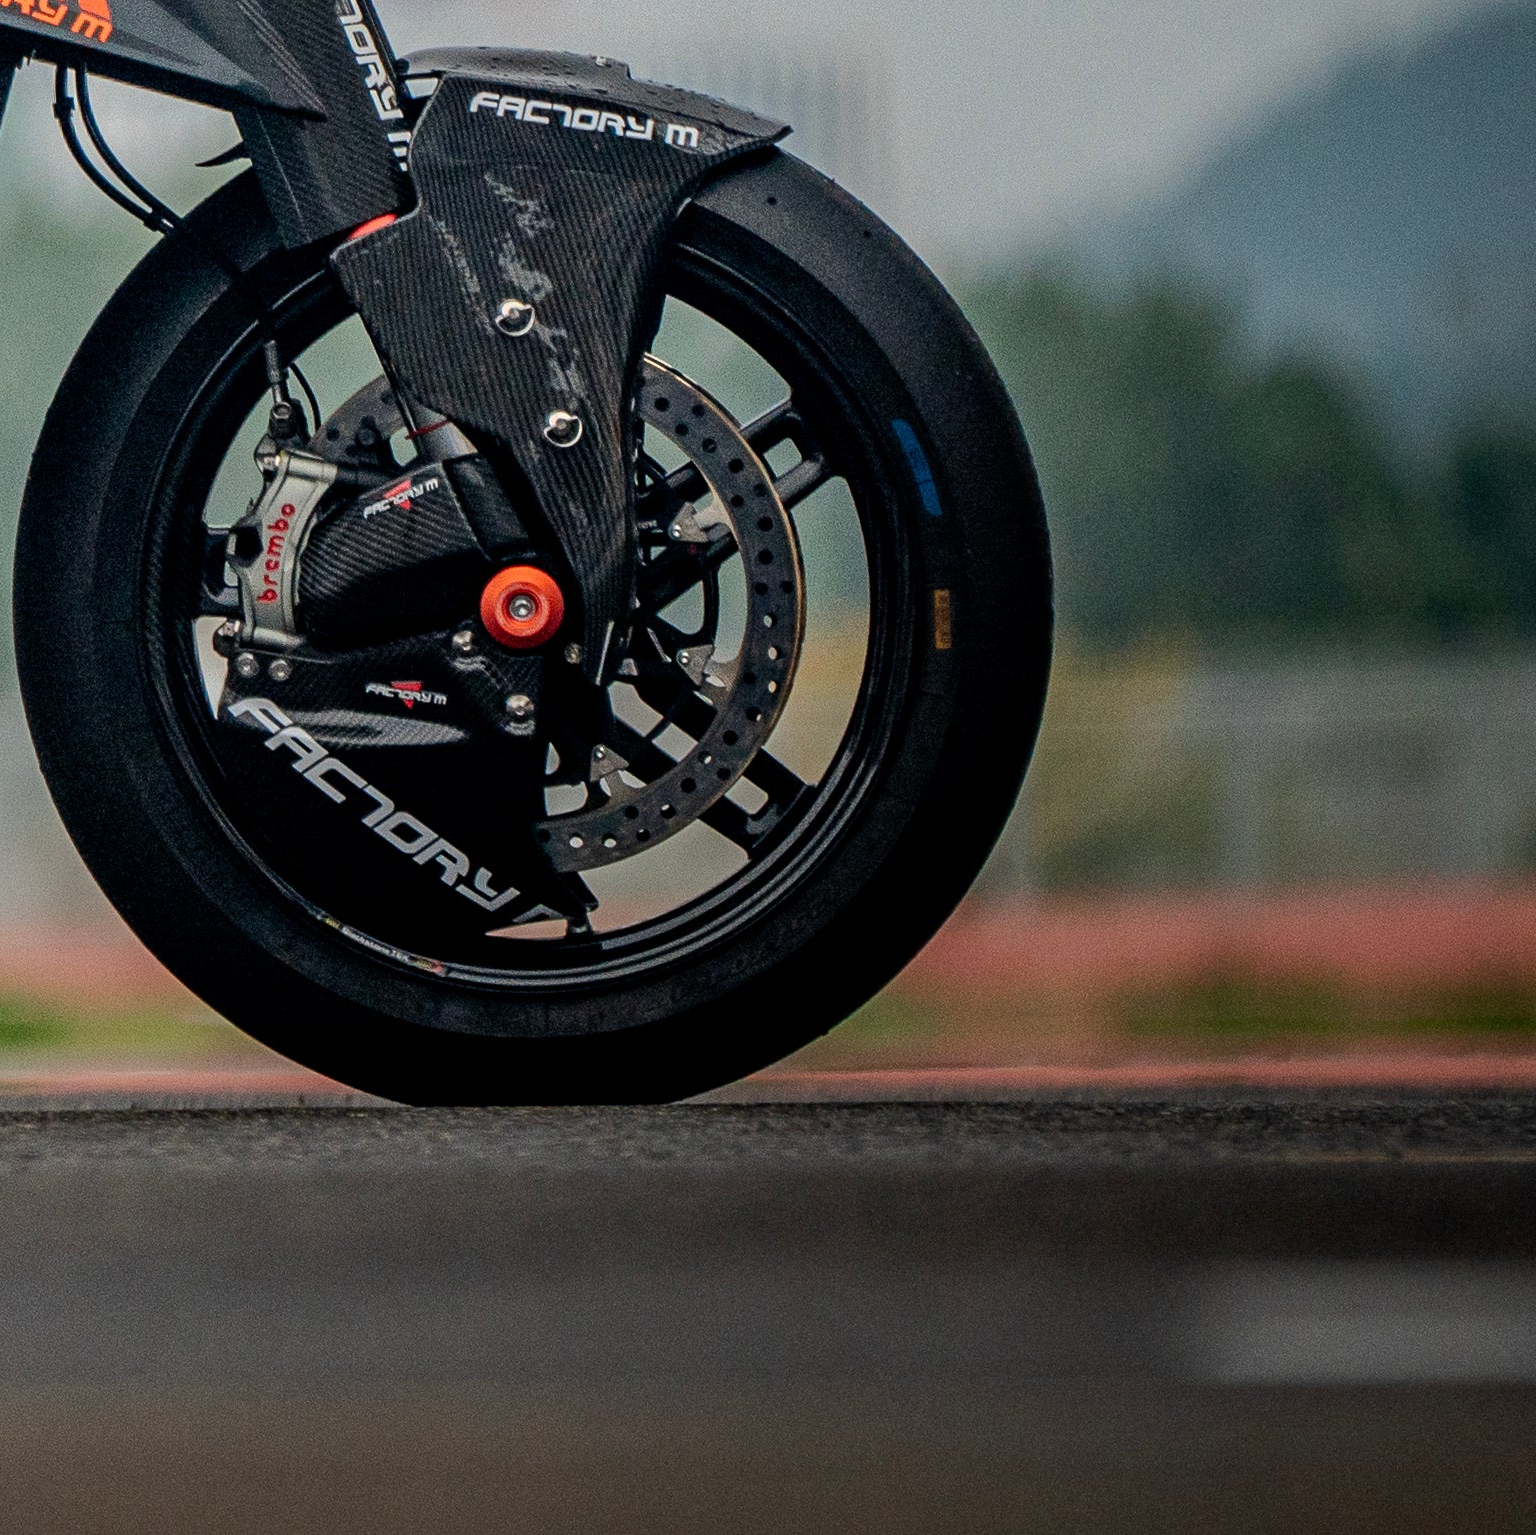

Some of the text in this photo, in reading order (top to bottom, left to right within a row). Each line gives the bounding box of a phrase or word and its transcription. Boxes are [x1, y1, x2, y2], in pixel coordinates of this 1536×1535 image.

[72, 11, 112, 42] M
[469, 92, 698, 149] FACTORY M
[363, 484, 424, 519] FACTORY
[257, 503, 296, 601] brembo
[365, 682, 431, 703] FACTORY
[228, 697, 521, 912] FACTORY
